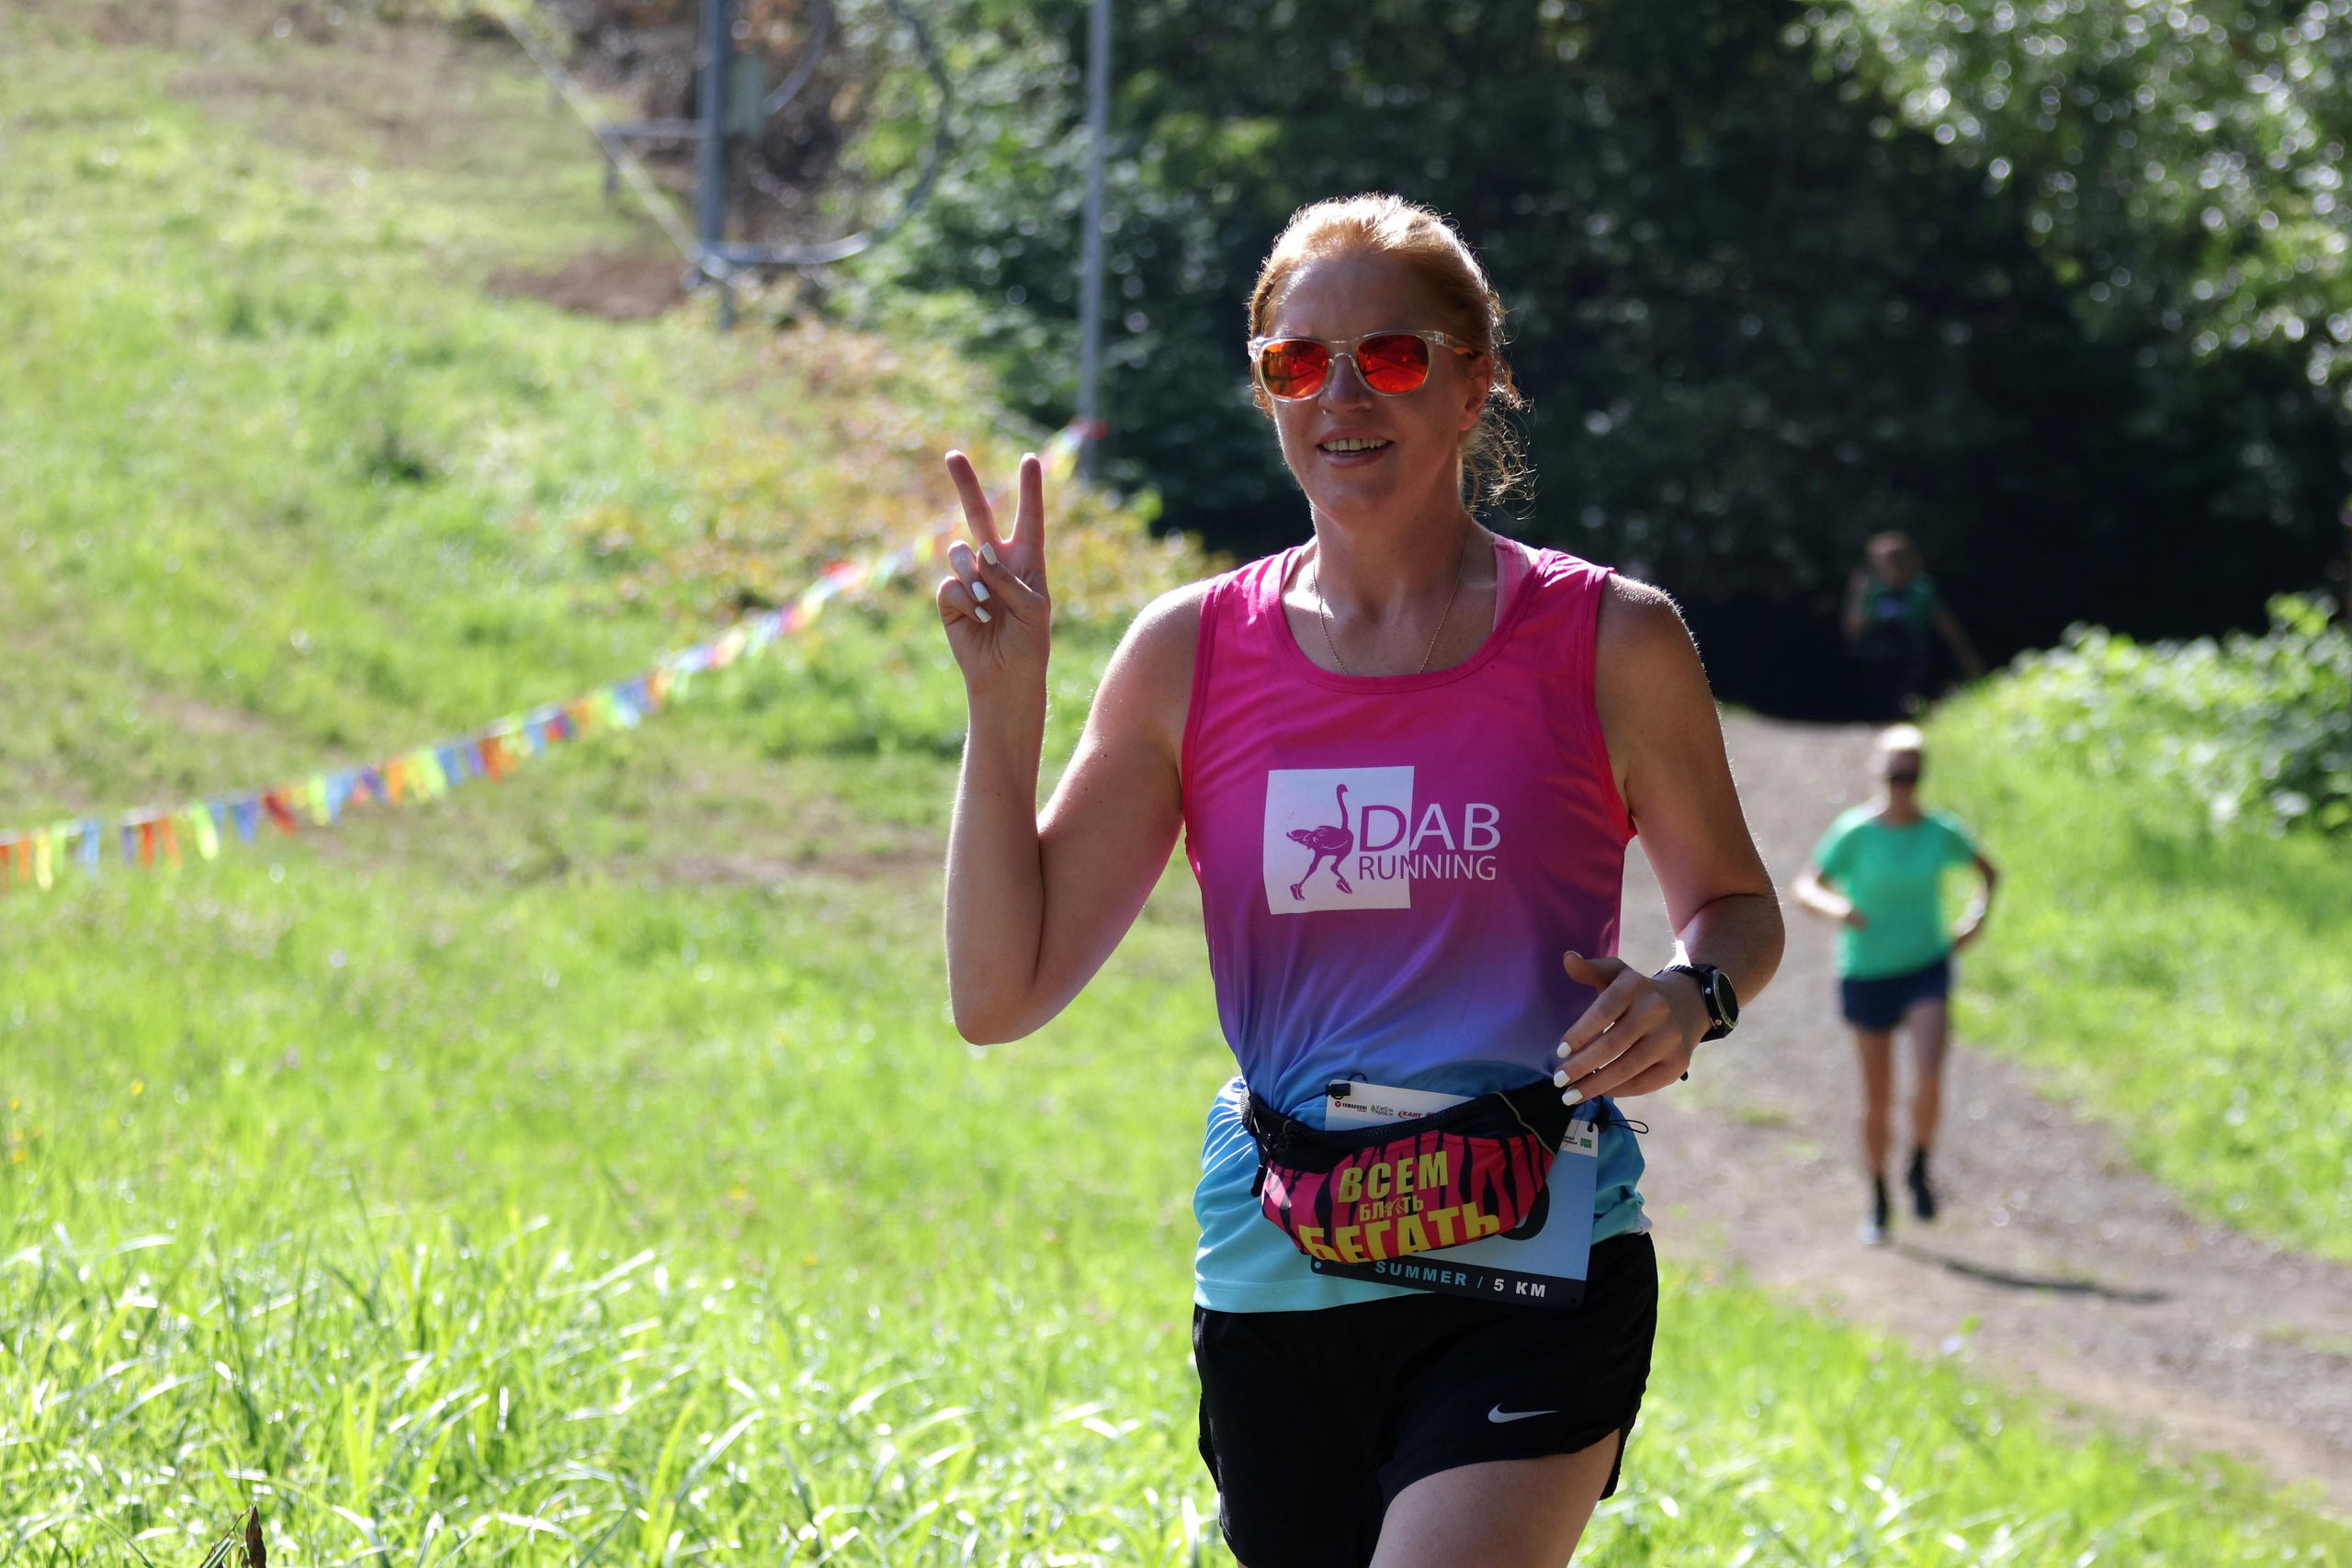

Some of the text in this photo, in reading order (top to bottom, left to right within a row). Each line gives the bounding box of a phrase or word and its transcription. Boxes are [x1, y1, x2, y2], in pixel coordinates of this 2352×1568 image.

[1359, 803, 1501, 852] DAB
[1359, 854, 1497, 881] RUNNING
[1342, 1102, 1367, 1111] YAMAGUCHI
[1338, 1151, 1448, 1203] ВСЕМ
[1298, 1201, 1500, 1263] БЕГАТЬ
[1374, 1260, 1467, 1286] SUMMER
[1493, 1278, 1504, 1292] 5
[1516, 1281, 1546, 1298] KM
